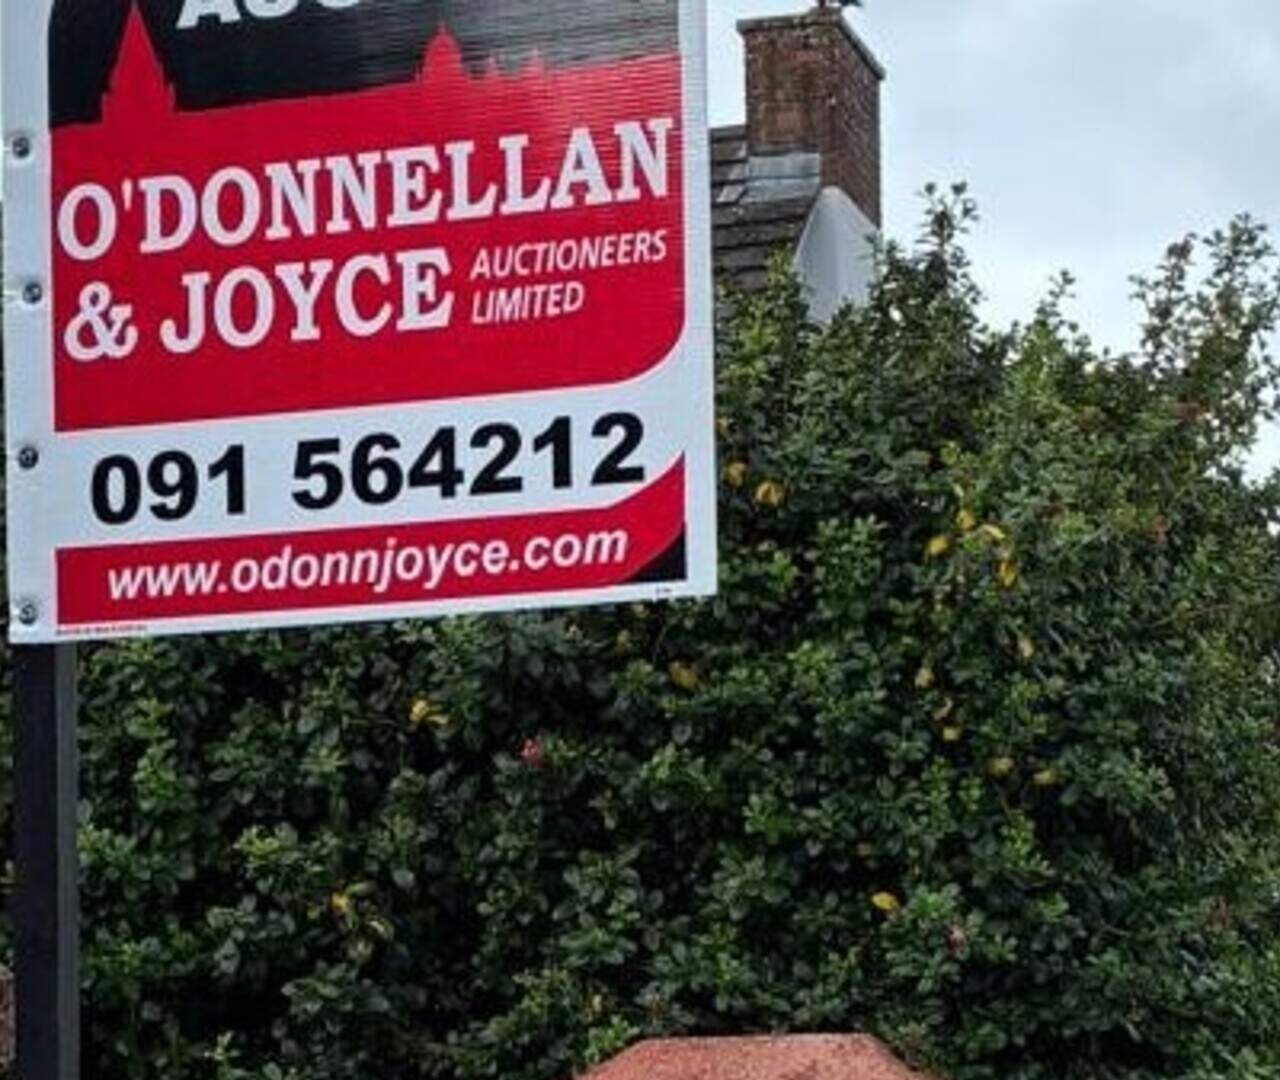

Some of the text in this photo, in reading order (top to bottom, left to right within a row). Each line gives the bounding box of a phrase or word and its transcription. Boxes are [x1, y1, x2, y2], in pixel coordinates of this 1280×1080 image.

[58, 118, 674, 261] O'DONNELLAN
[470, 230, 667, 280] AUCTIONEERS
[63, 248, 455, 361] & JOYCE
[471, 281, 584, 325] LIMITED
[90, 412, 645, 526] 091 564212
[108, 528, 627, 601] www.odonnjoyce.com
